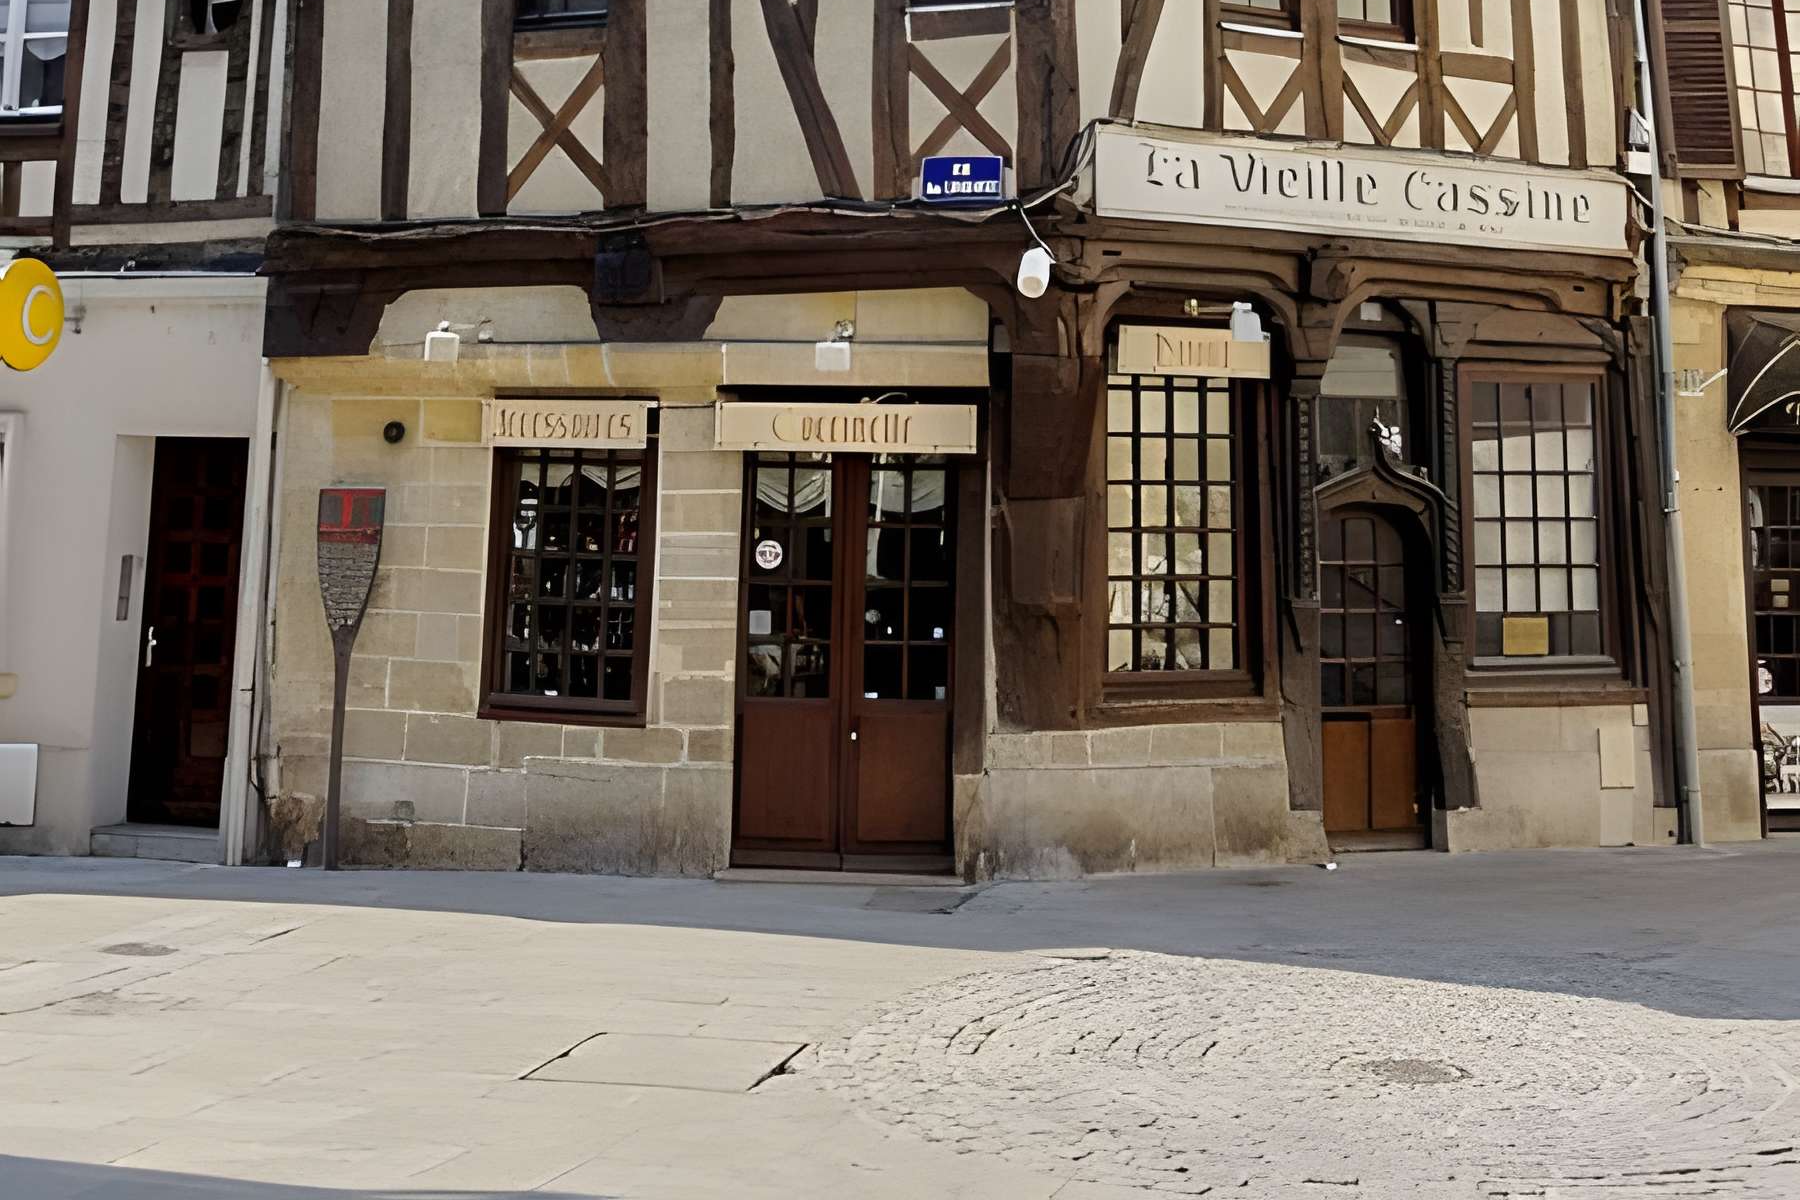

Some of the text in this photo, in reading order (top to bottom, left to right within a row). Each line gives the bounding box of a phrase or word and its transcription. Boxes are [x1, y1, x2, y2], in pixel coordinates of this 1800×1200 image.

[1138, 142, 1592, 224] La Vieille Cassine
